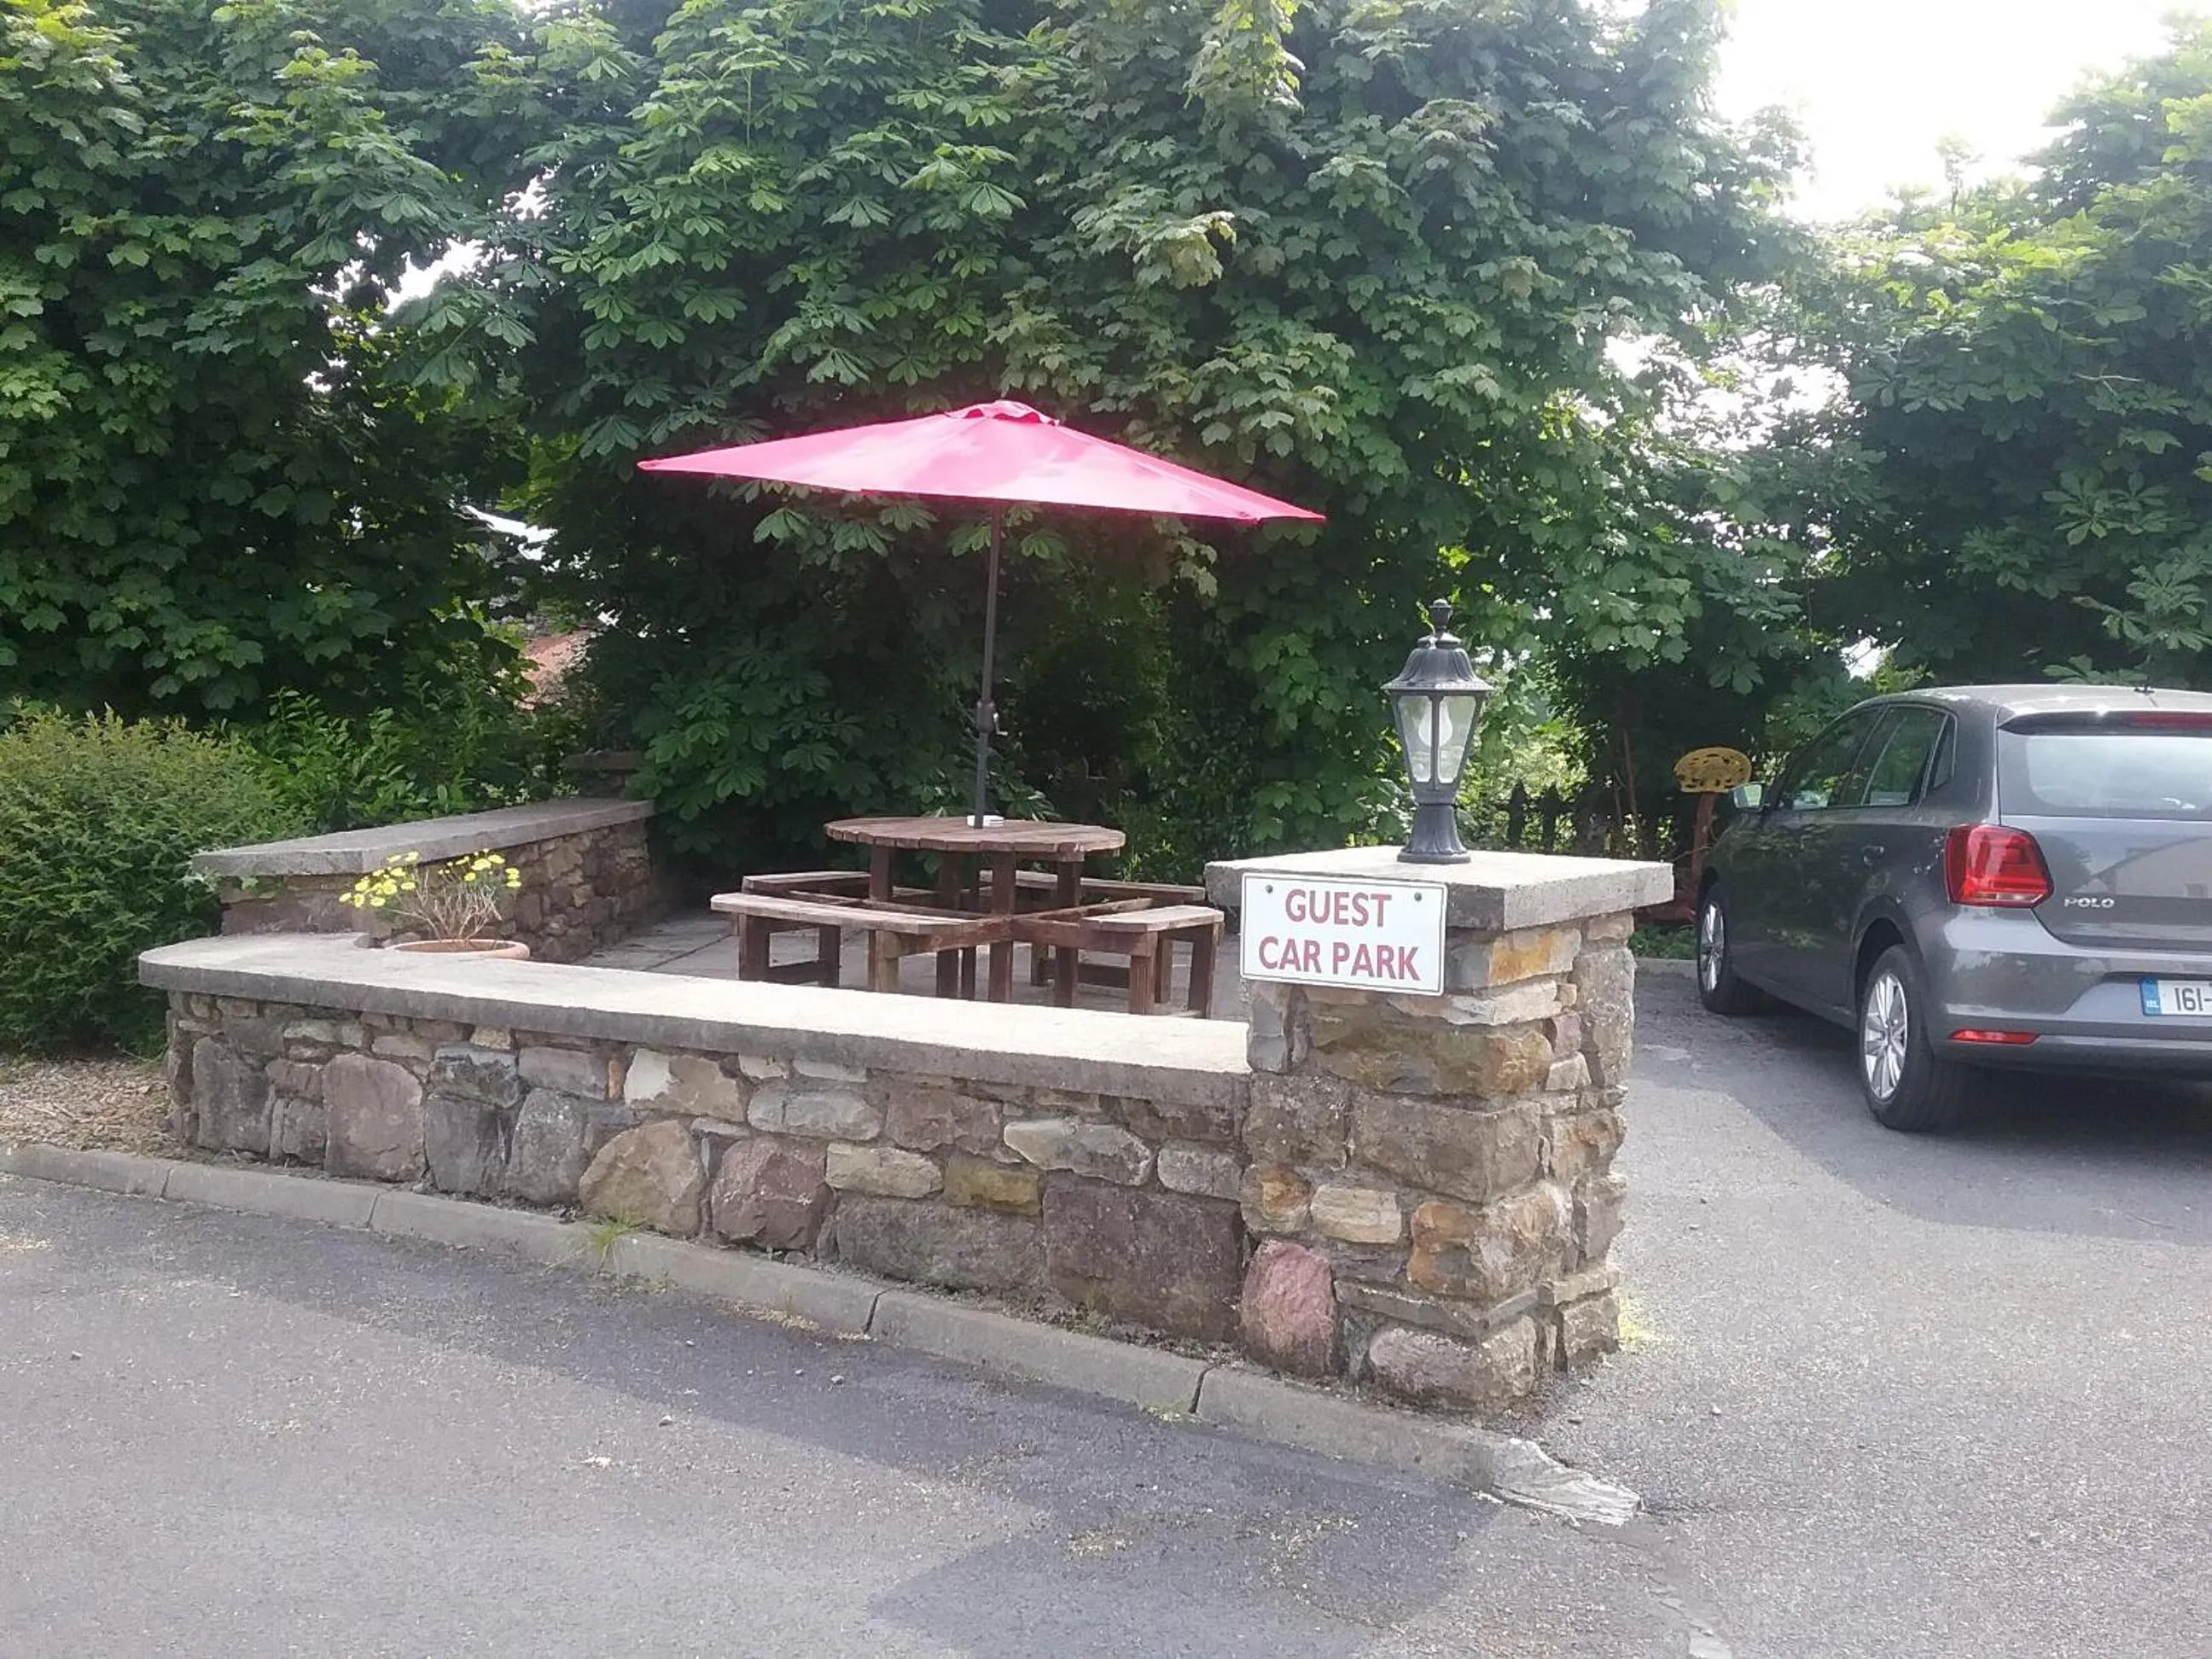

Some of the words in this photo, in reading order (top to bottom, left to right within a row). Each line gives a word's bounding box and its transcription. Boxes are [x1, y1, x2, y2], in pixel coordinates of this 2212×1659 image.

[1285, 888, 1392, 928] GUEST
[2064, 897, 2115, 908] POLO
[1259, 936, 1322, 974] CAR
[1332, 941, 1422, 981] PARK
